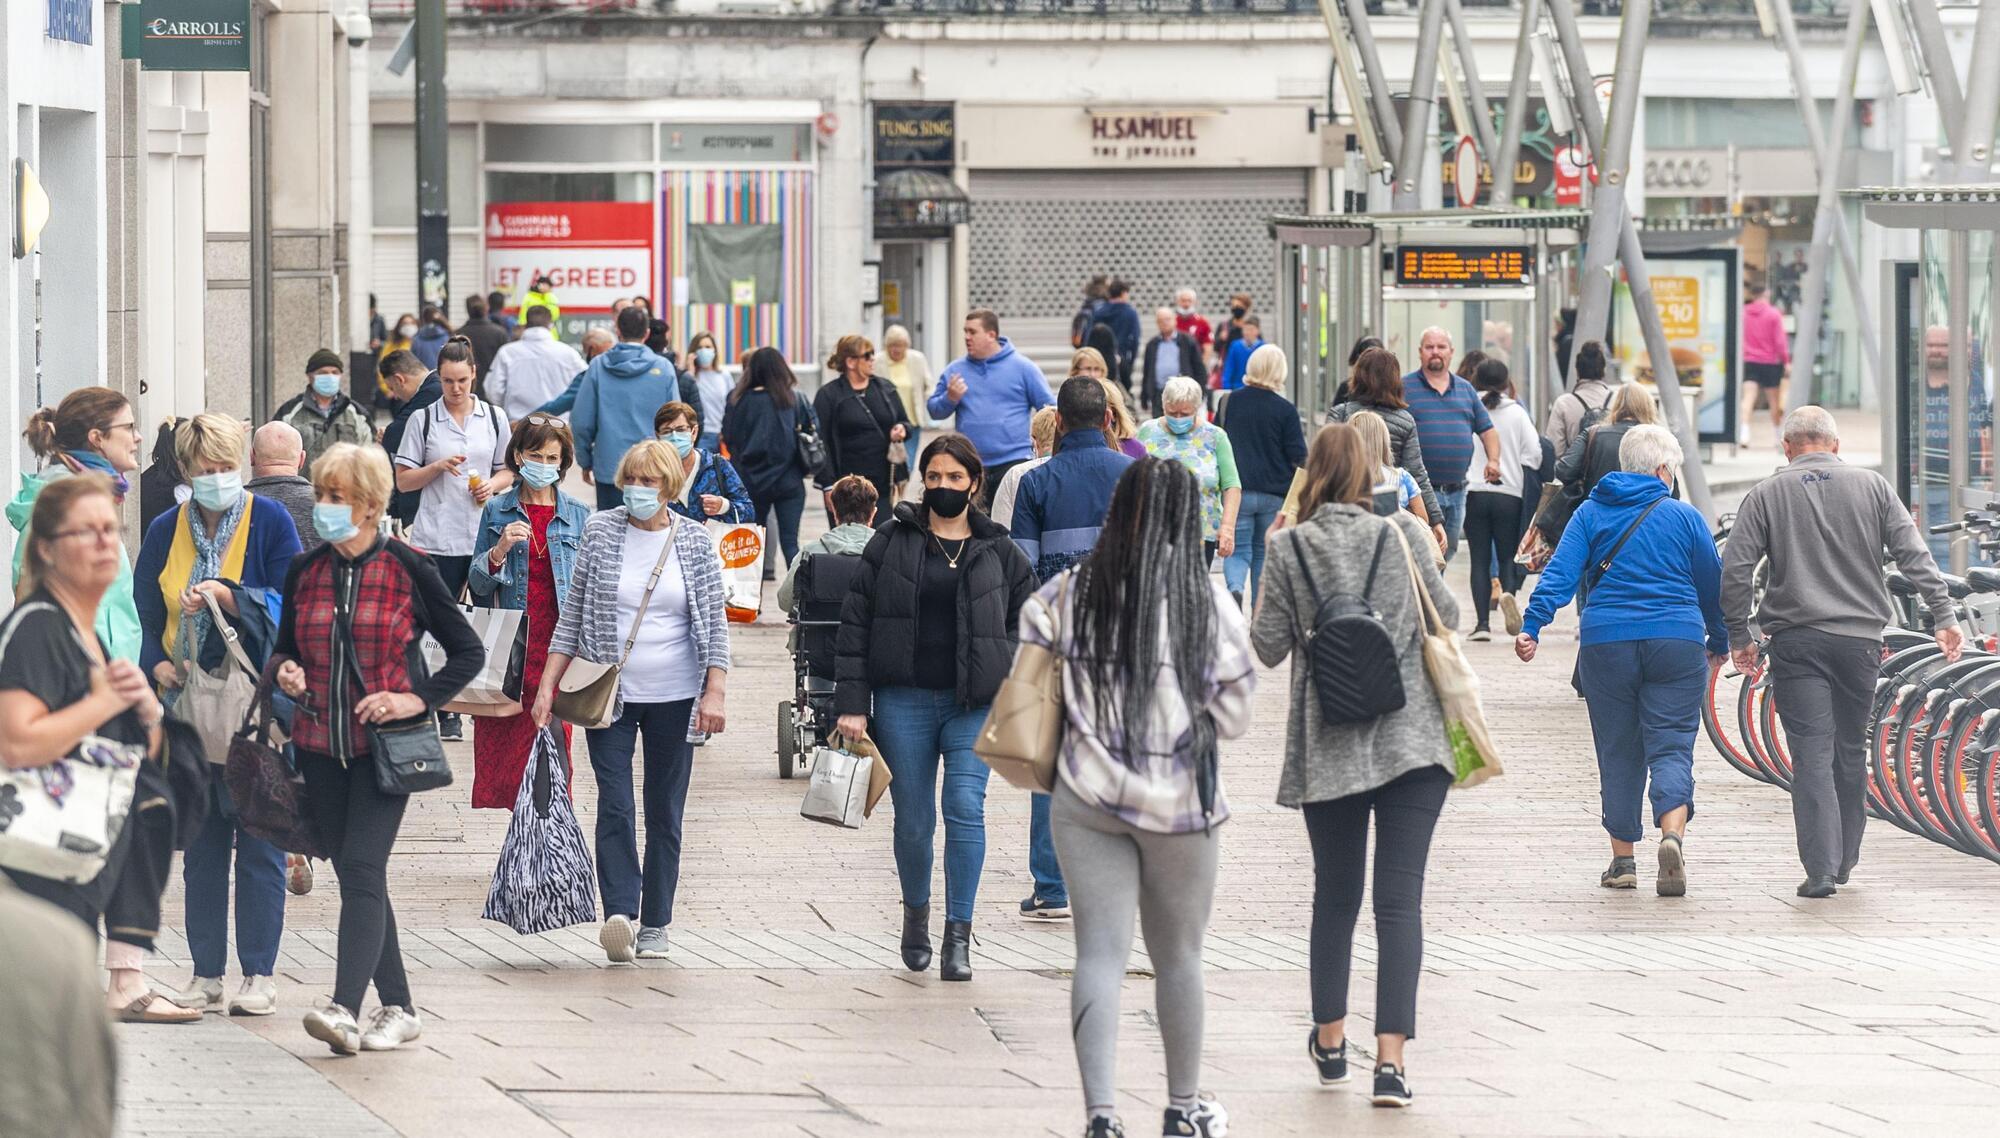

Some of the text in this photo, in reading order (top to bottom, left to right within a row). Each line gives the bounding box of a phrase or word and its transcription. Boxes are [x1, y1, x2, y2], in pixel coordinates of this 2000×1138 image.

[152, 18, 241, 36] CARROLLS
[879, 120, 953, 137] TUNG SING
[1092, 116, 1196, 140] H.SAMUEL
[1093, 146, 1196, 160] THE JEWELLER
[504, 226, 572, 238] WAKEFIELD
[492, 268, 637, 288] LET AGREED
[721, 534, 755, 554] Get it at
[725, 545, 760, 561] GUINEYS
[424, 640, 442, 650] BRO
